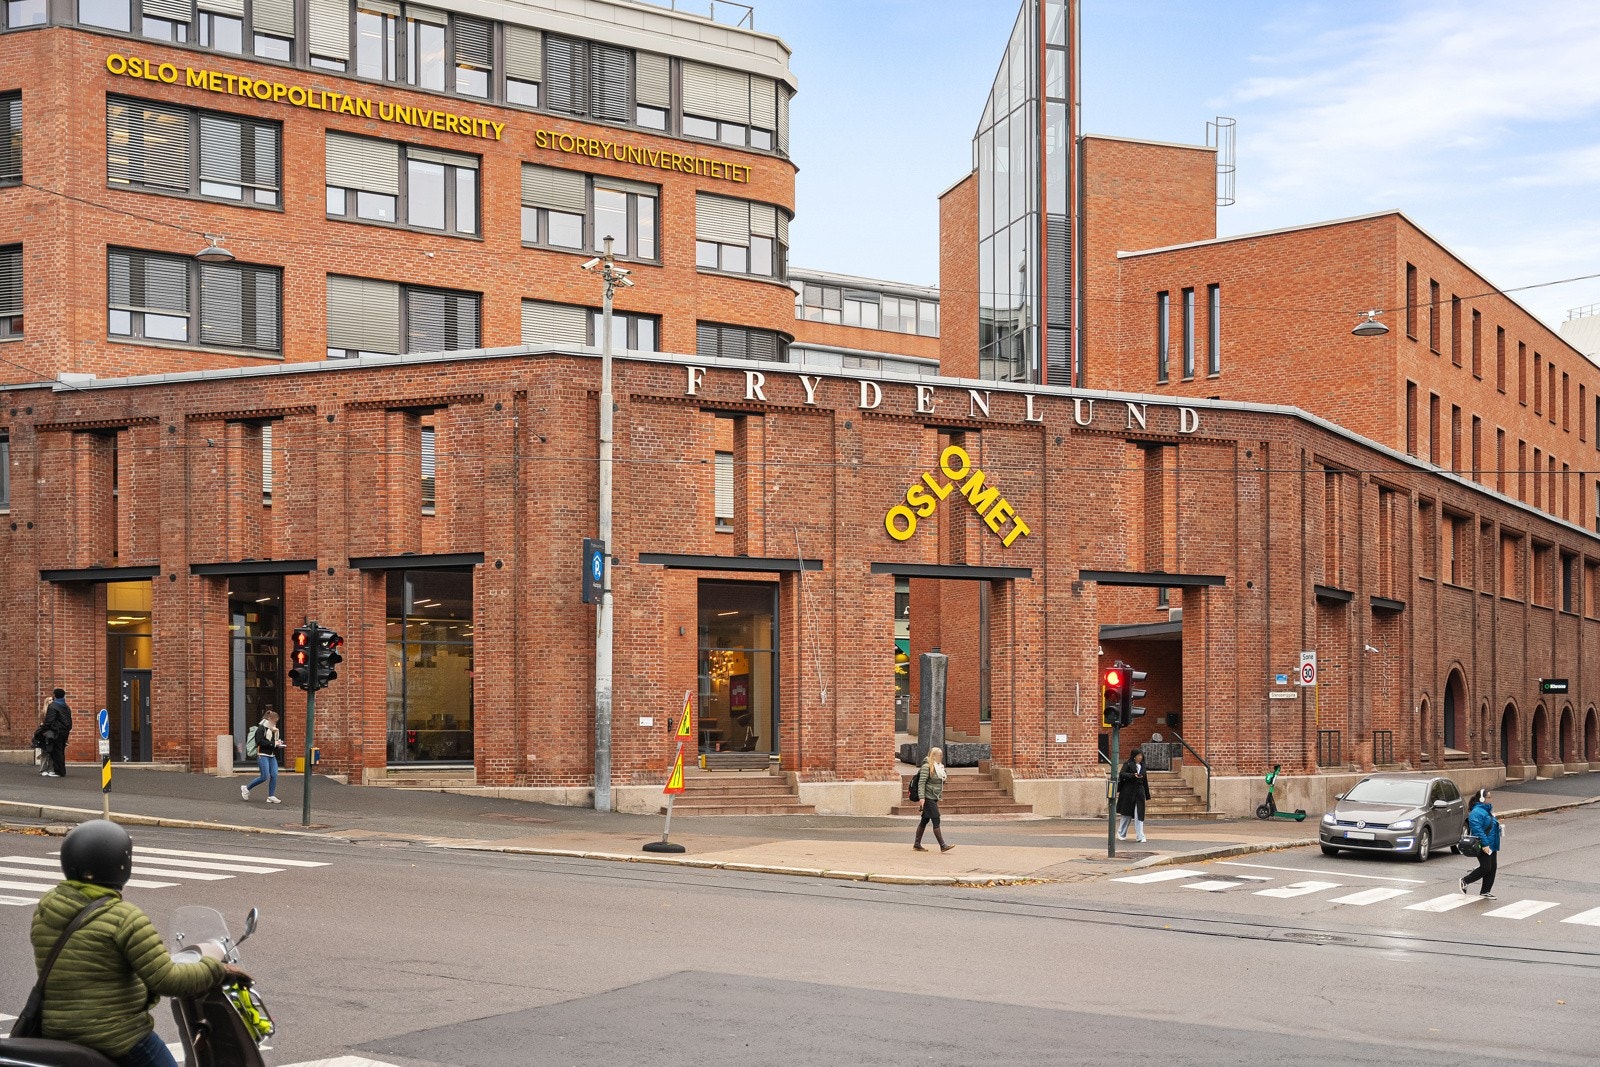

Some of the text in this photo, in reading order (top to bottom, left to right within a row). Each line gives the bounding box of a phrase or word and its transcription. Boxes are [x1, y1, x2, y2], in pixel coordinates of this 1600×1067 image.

[106, 53, 506, 141] OSLO METROPOLITAN UNIVERSITY
[535, 129, 752, 183] STORBYUNIVERSITETET
[685, 366, 1199, 434] FRYDENLUND
[1304, 668, 1312, 678] 30
